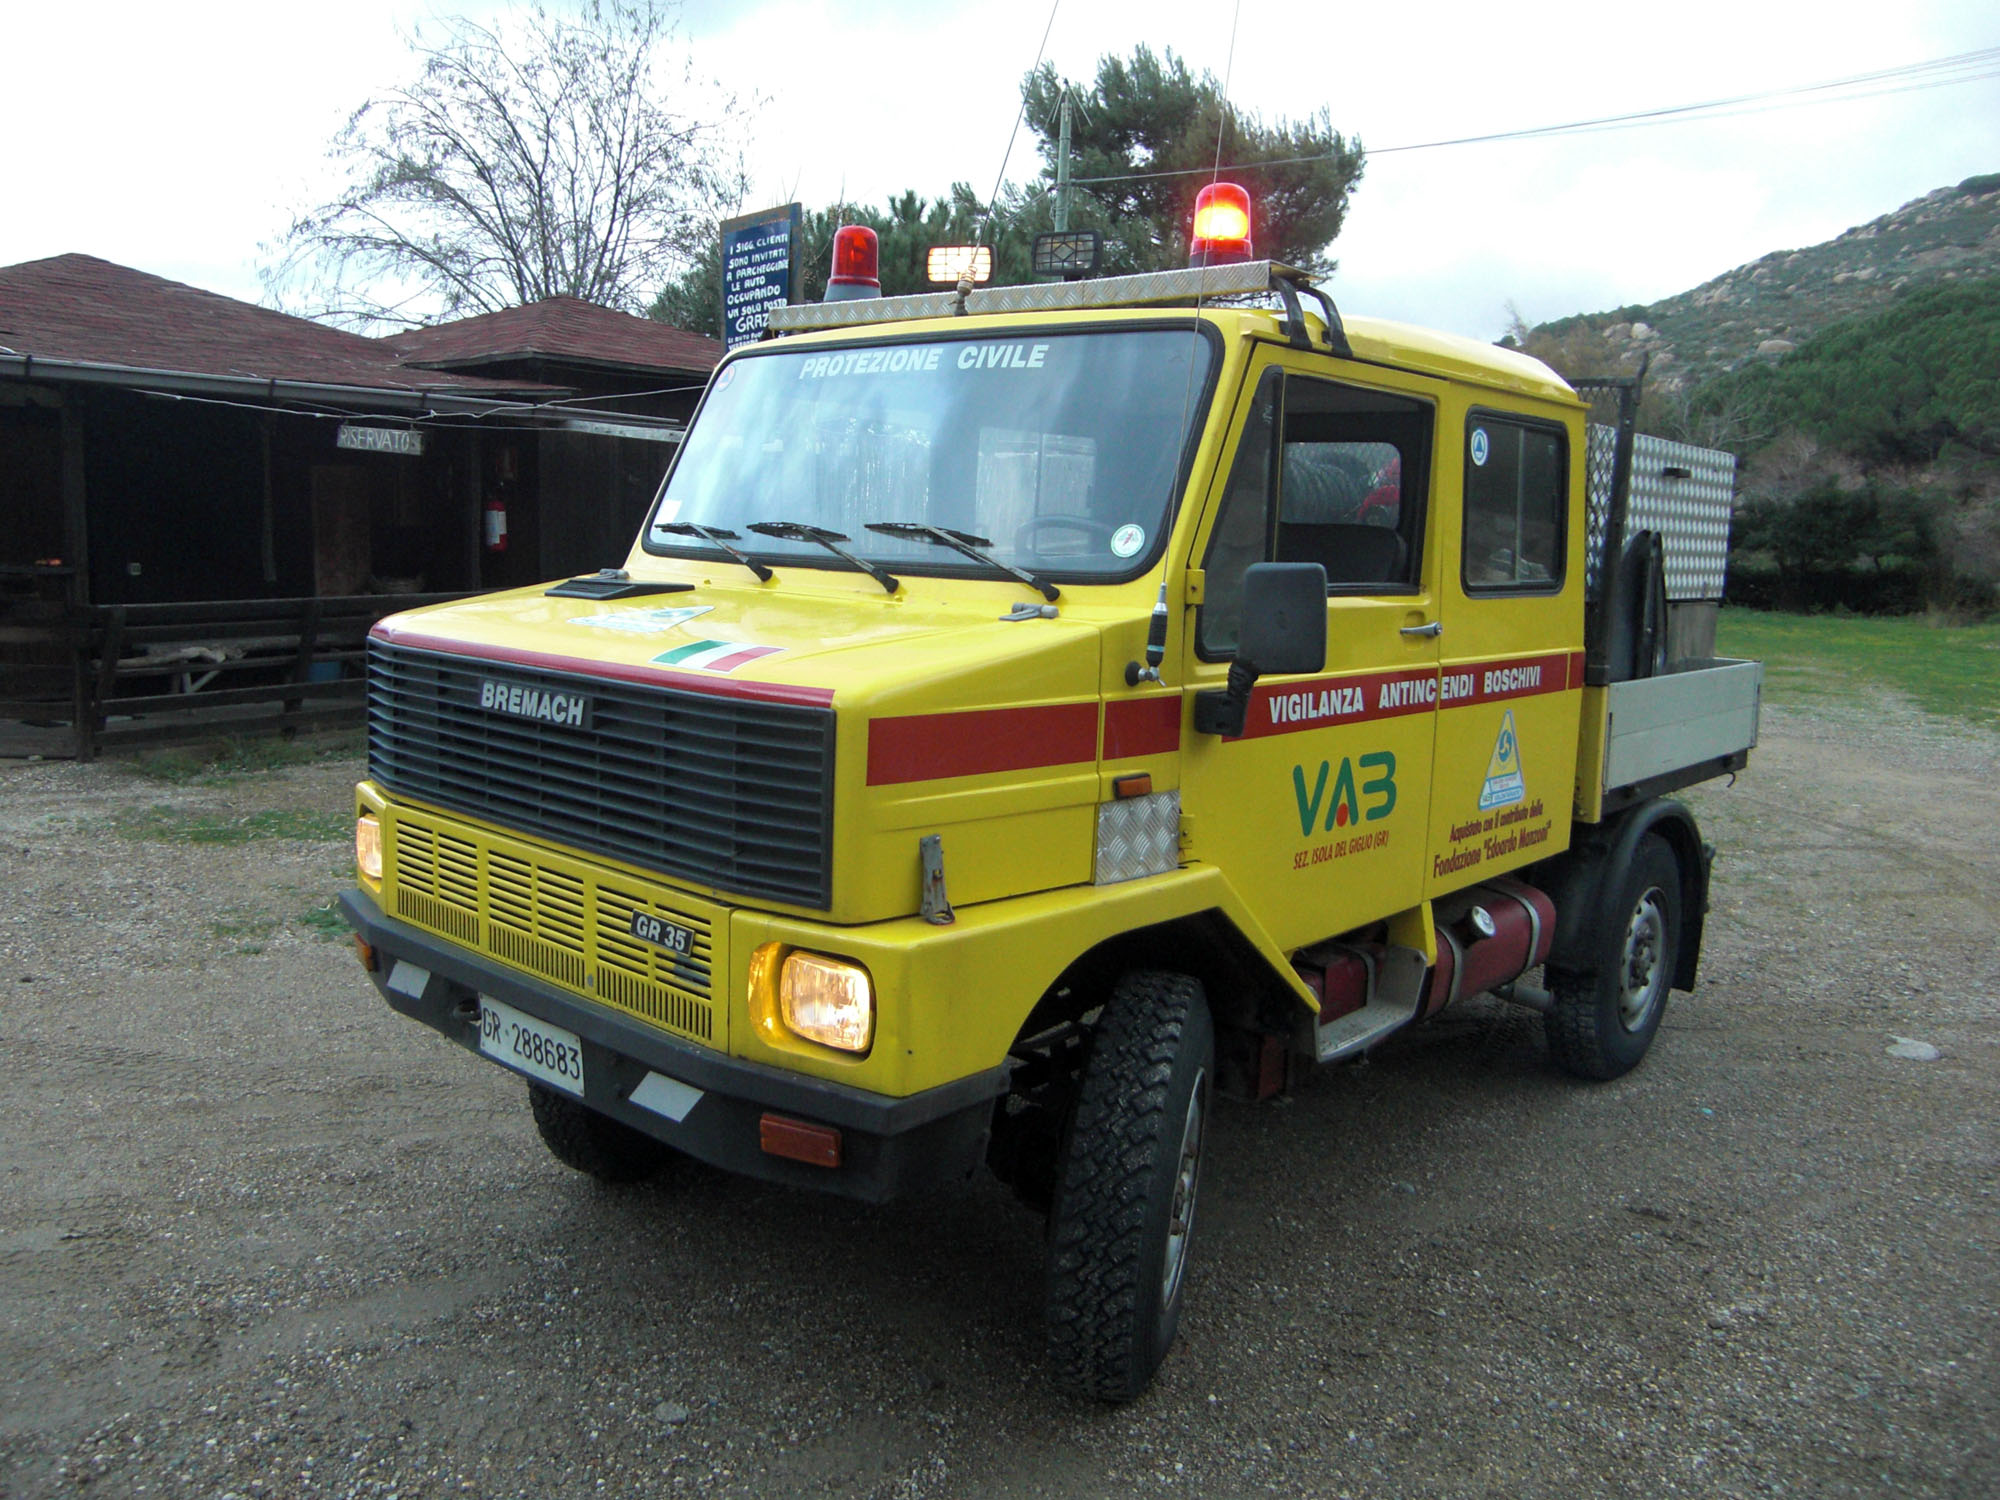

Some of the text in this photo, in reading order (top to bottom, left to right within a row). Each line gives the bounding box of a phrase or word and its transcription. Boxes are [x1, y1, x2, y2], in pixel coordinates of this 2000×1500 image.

[756, 233, 788, 247] CLIENTI
[728, 248, 785, 269] SONO INVITATI
[726, 272, 732, 281] A
[731, 275, 766, 292] LE AUTO
[727, 285, 781, 305] OCCUPANDO
[727, 298, 788, 319] UN SOLO POSTO
[735, 313, 769, 333] GRAZ
[799, 344, 1049, 379] PROTEZIONE CIVILE
[341, 428, 410, 452] RISERVATO
[481, 682, 584, 726] BREMACH
[1268, 665, 1540, 724] VIGILANZA ANTINCENDI BOSCHIVI
[1293, 751, 1397, 837] VAB
[1449, 818, 1482, 844] Acquistato
[1483, 817, 1493, 832] con
[1494, 809, 1500, 829] il
[1500, 804, 1528, 826] contributo
[1293, 830, 1389, 870] SEZ. ISOLA DEL GIGLIO (GR)
[1433, 819, 1551, 878] Fondazione "Edoardo Manzoni"
[636, 915, 687, 951] GR 35
[483, 1007, 580, 1080] GR 288683
